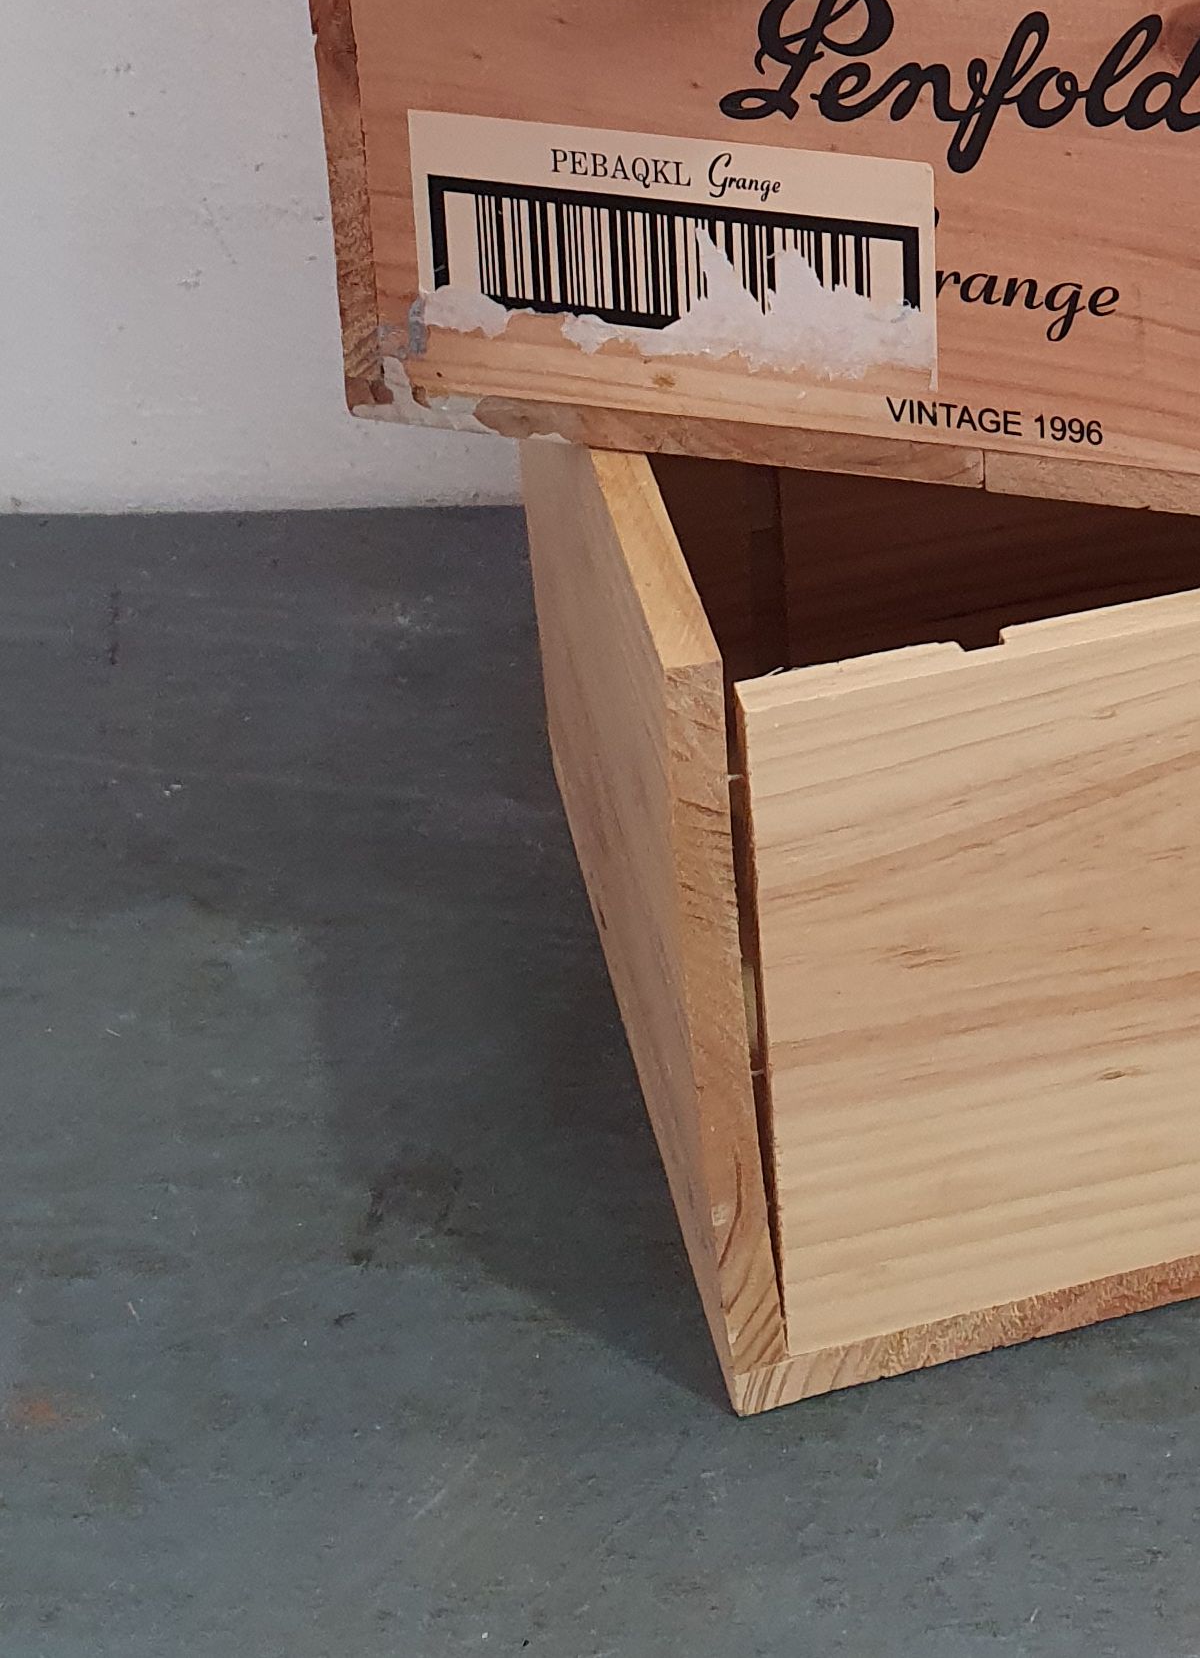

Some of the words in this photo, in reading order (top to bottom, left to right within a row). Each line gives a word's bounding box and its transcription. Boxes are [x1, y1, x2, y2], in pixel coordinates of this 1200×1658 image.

[550, 149, 692, 188] PEBAQKL
[708, 153, 781, 202] Grange
[935, 268, 1121, 342] range
[886, 396, 1023, 437] VINTAGE
[1034, 414, 1104, 446] 1996
